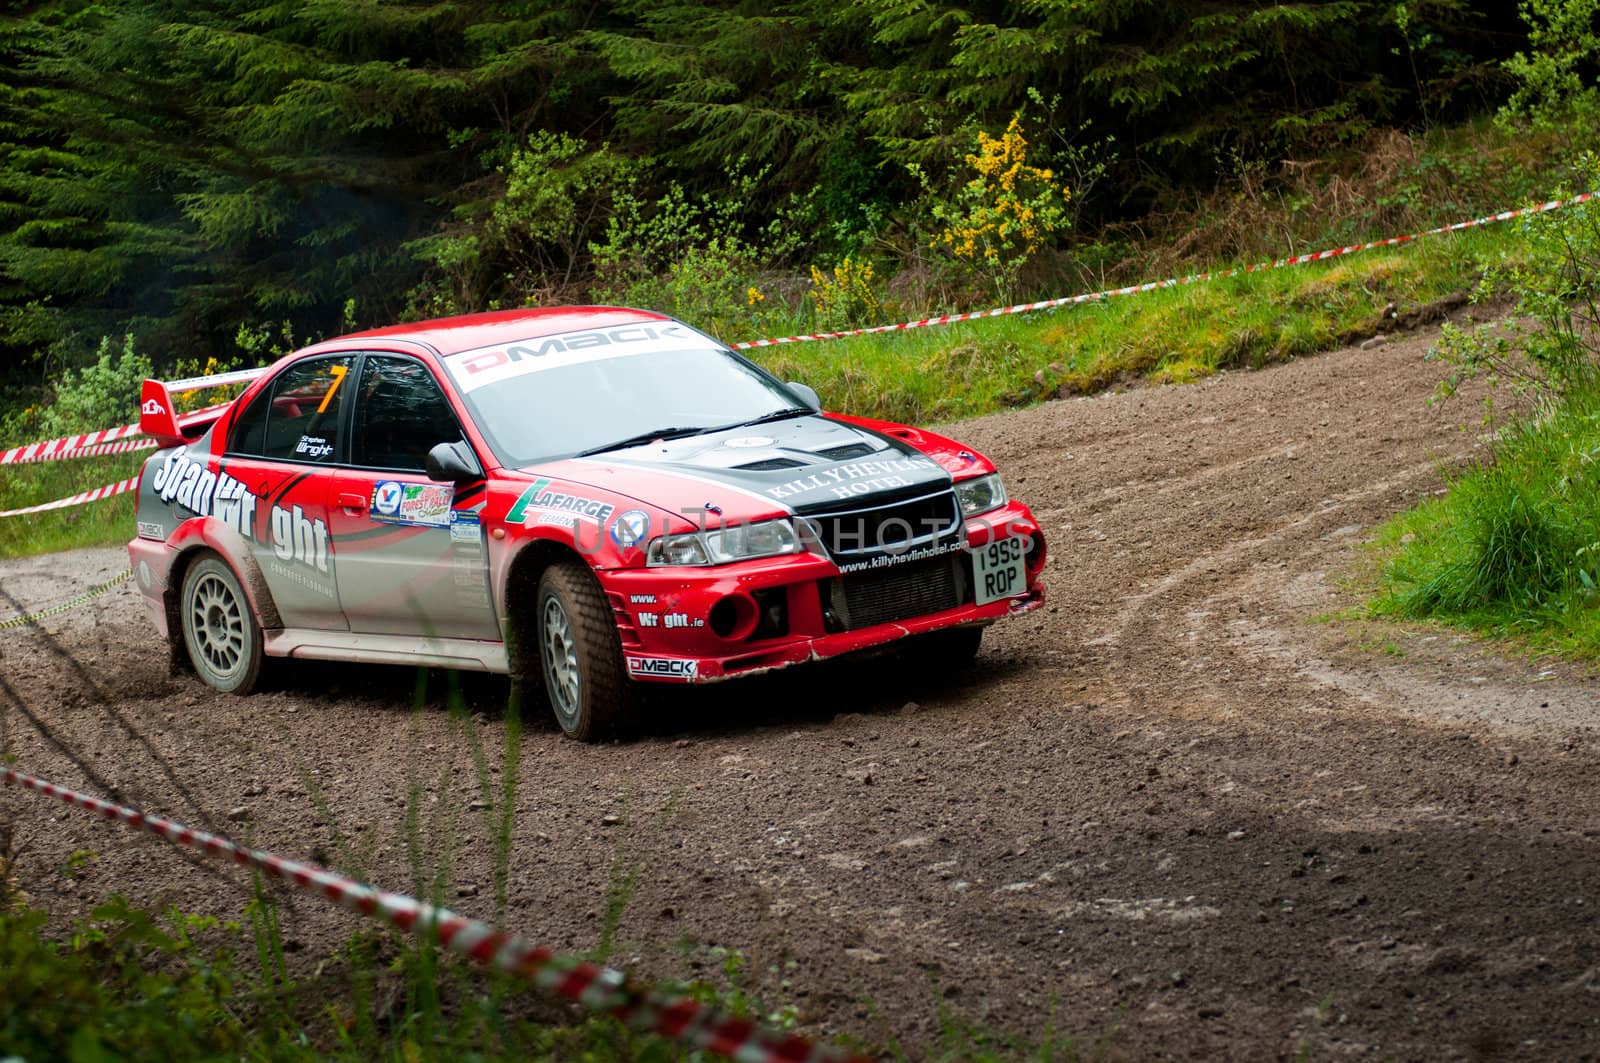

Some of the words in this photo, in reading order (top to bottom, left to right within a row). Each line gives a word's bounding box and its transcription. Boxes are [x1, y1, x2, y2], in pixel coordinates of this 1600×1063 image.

[461, 327, 690, 375] DMACK
[316, 365, 349, 414] 7
[830, 475, 915, 500] HOTEL
[529, 490, 613, 520] LAFARGE
[984, 566, 1017, 598] ROP
[630, 594, 657, 604] www.
[630, 658, 694, 674] DMACK
